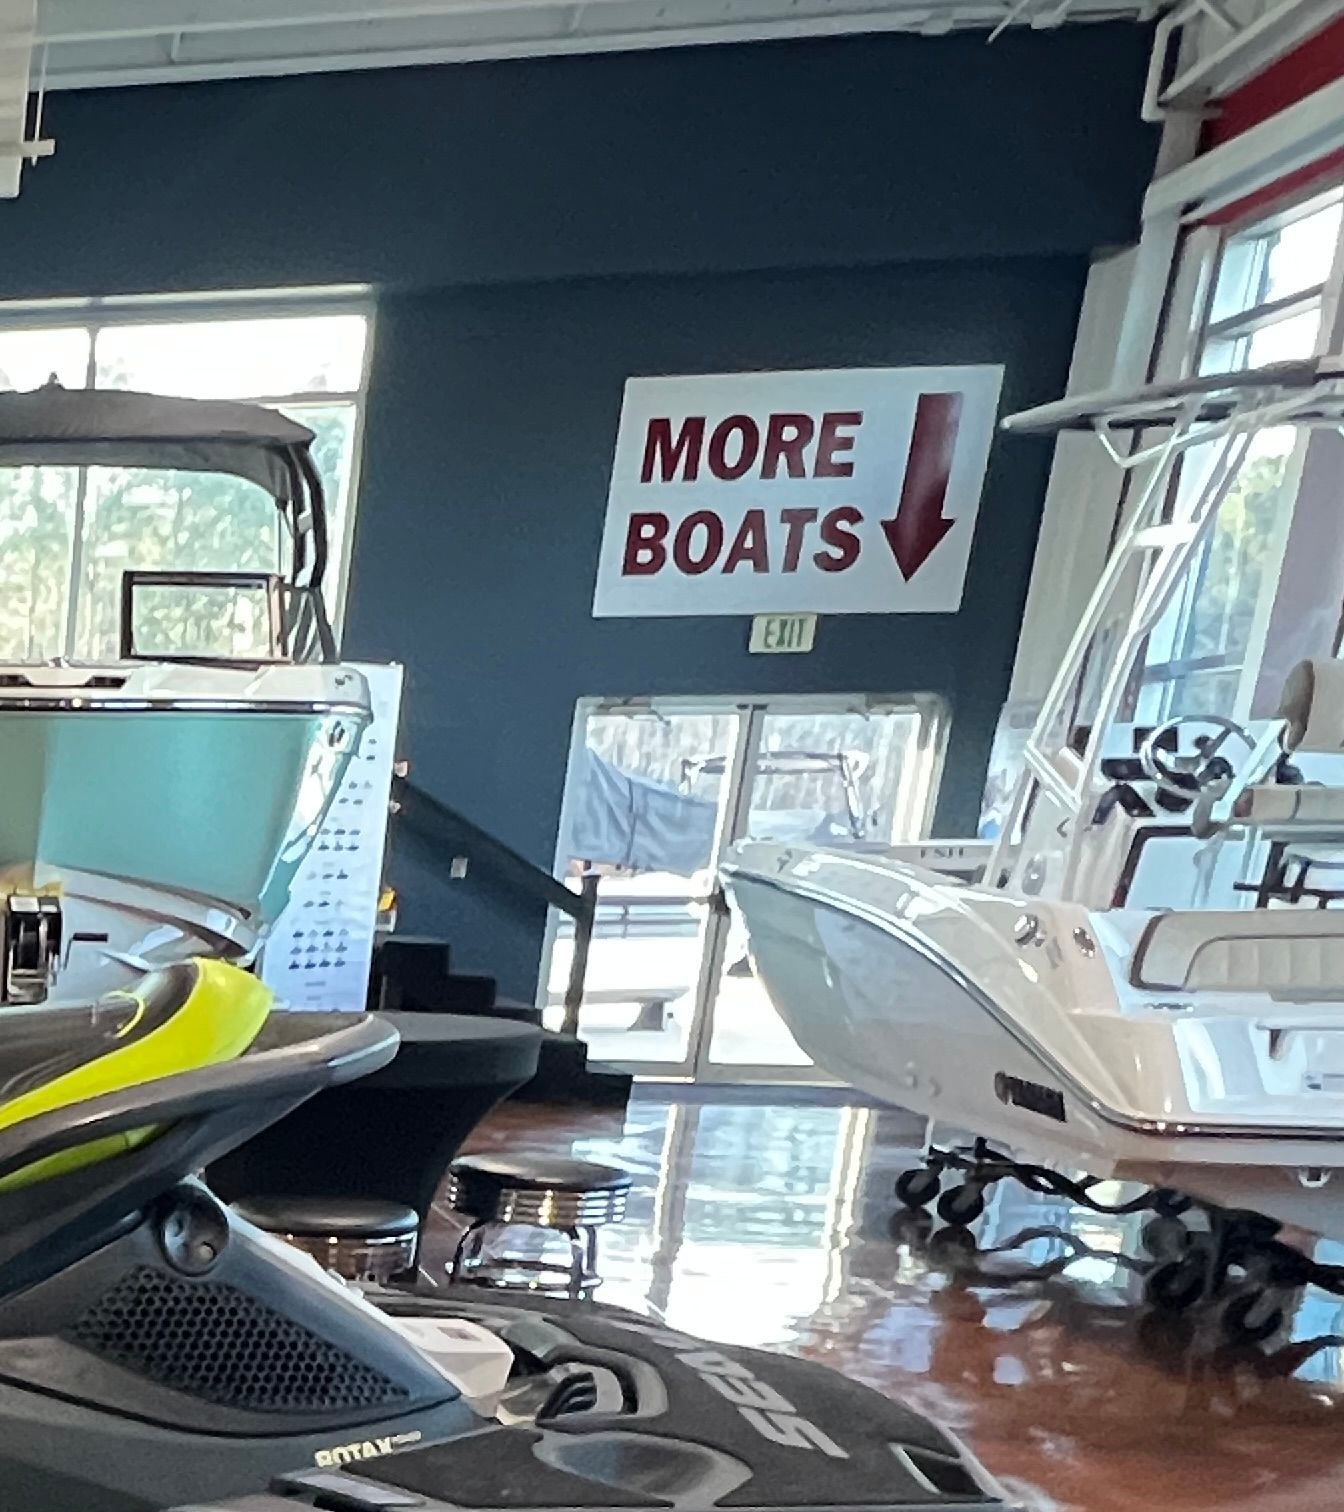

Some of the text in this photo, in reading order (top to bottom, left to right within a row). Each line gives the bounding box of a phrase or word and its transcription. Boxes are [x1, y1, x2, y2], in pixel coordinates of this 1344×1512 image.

[640, 410, 864, 484] MORE
[620, 506, 865, 578] BOATS
[762, 617, 808, 649] EXIT
